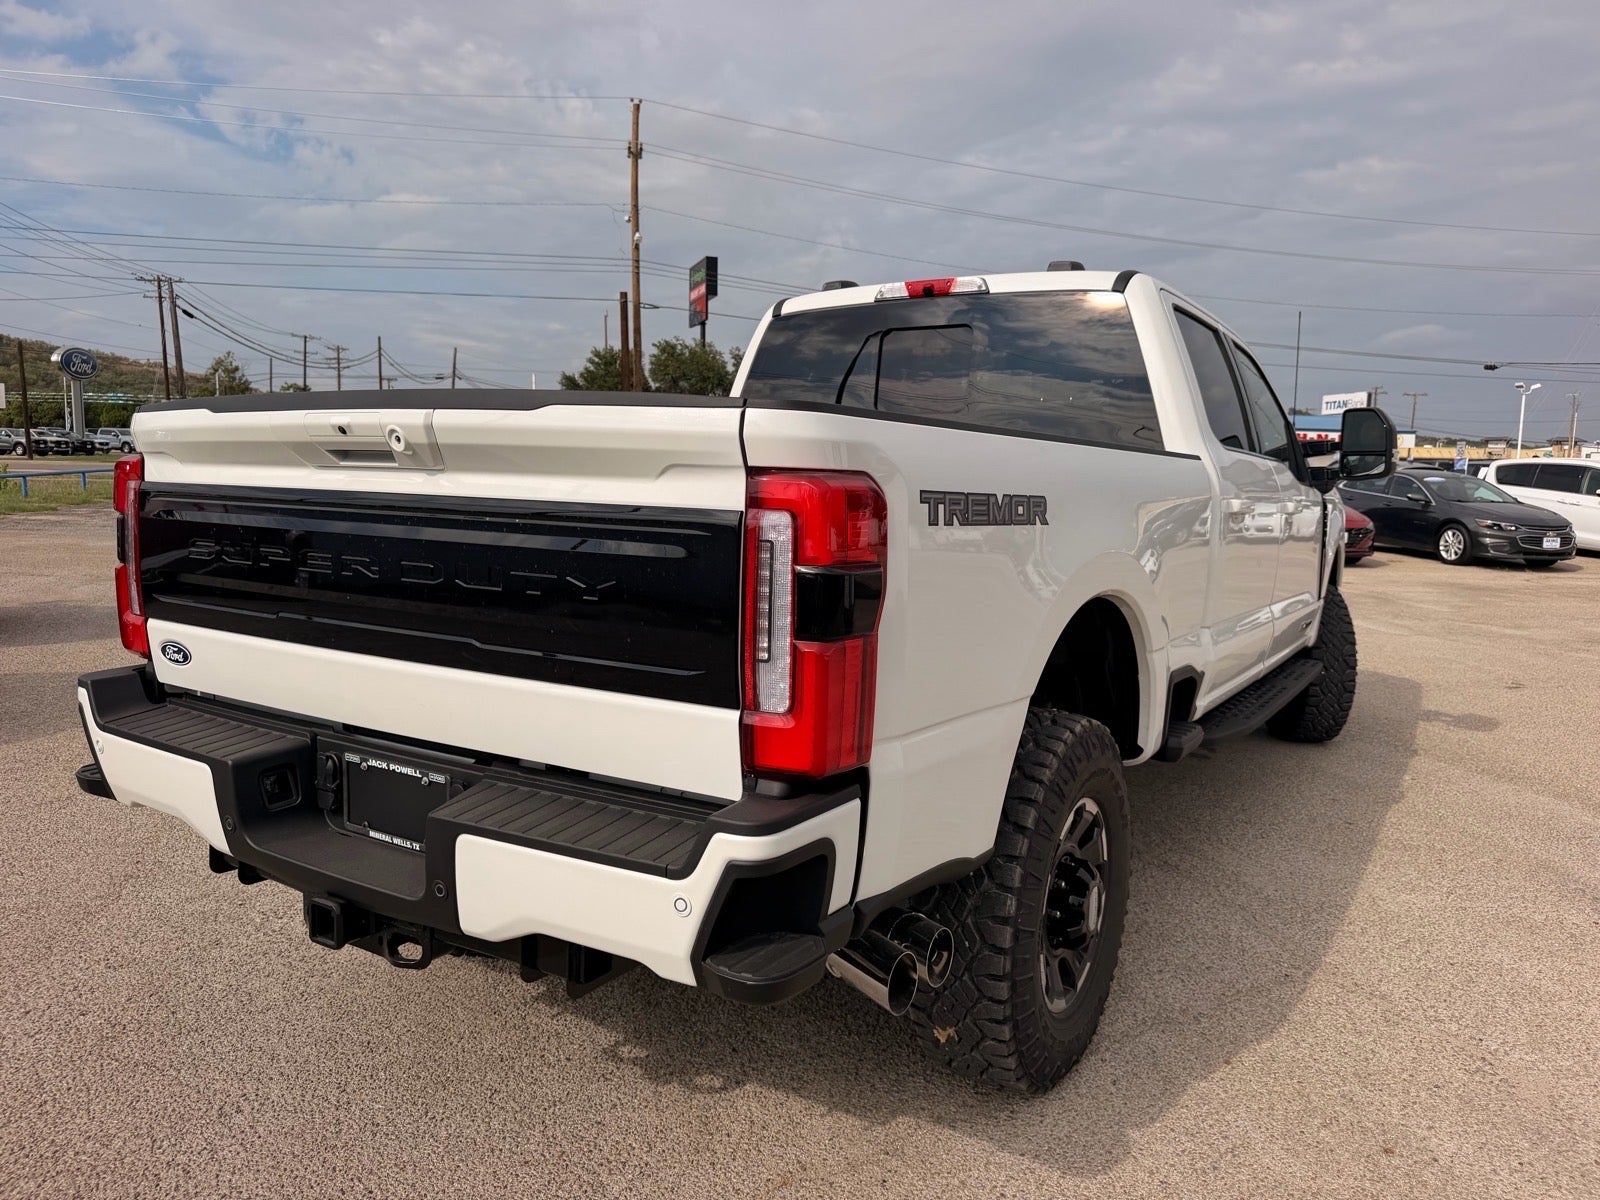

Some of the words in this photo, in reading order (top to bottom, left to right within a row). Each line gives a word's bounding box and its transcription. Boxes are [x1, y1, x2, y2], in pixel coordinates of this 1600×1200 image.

[70, 353, 93, 374] Ford
[919, 489, 1049, 526] TREMOR
[188, 538, 379, 578] SUPER
[401, 561, 616, 600] DUTY
[165, 645, 184, 662] Ford
[367, 759, 388, 770] JACK
[389, 763, 422, 778] POWELL
[369, 830, 392, 843] MINERAL
[392, 837, 412, 849] WELLS,
[412, 843, 420, 851] TX
